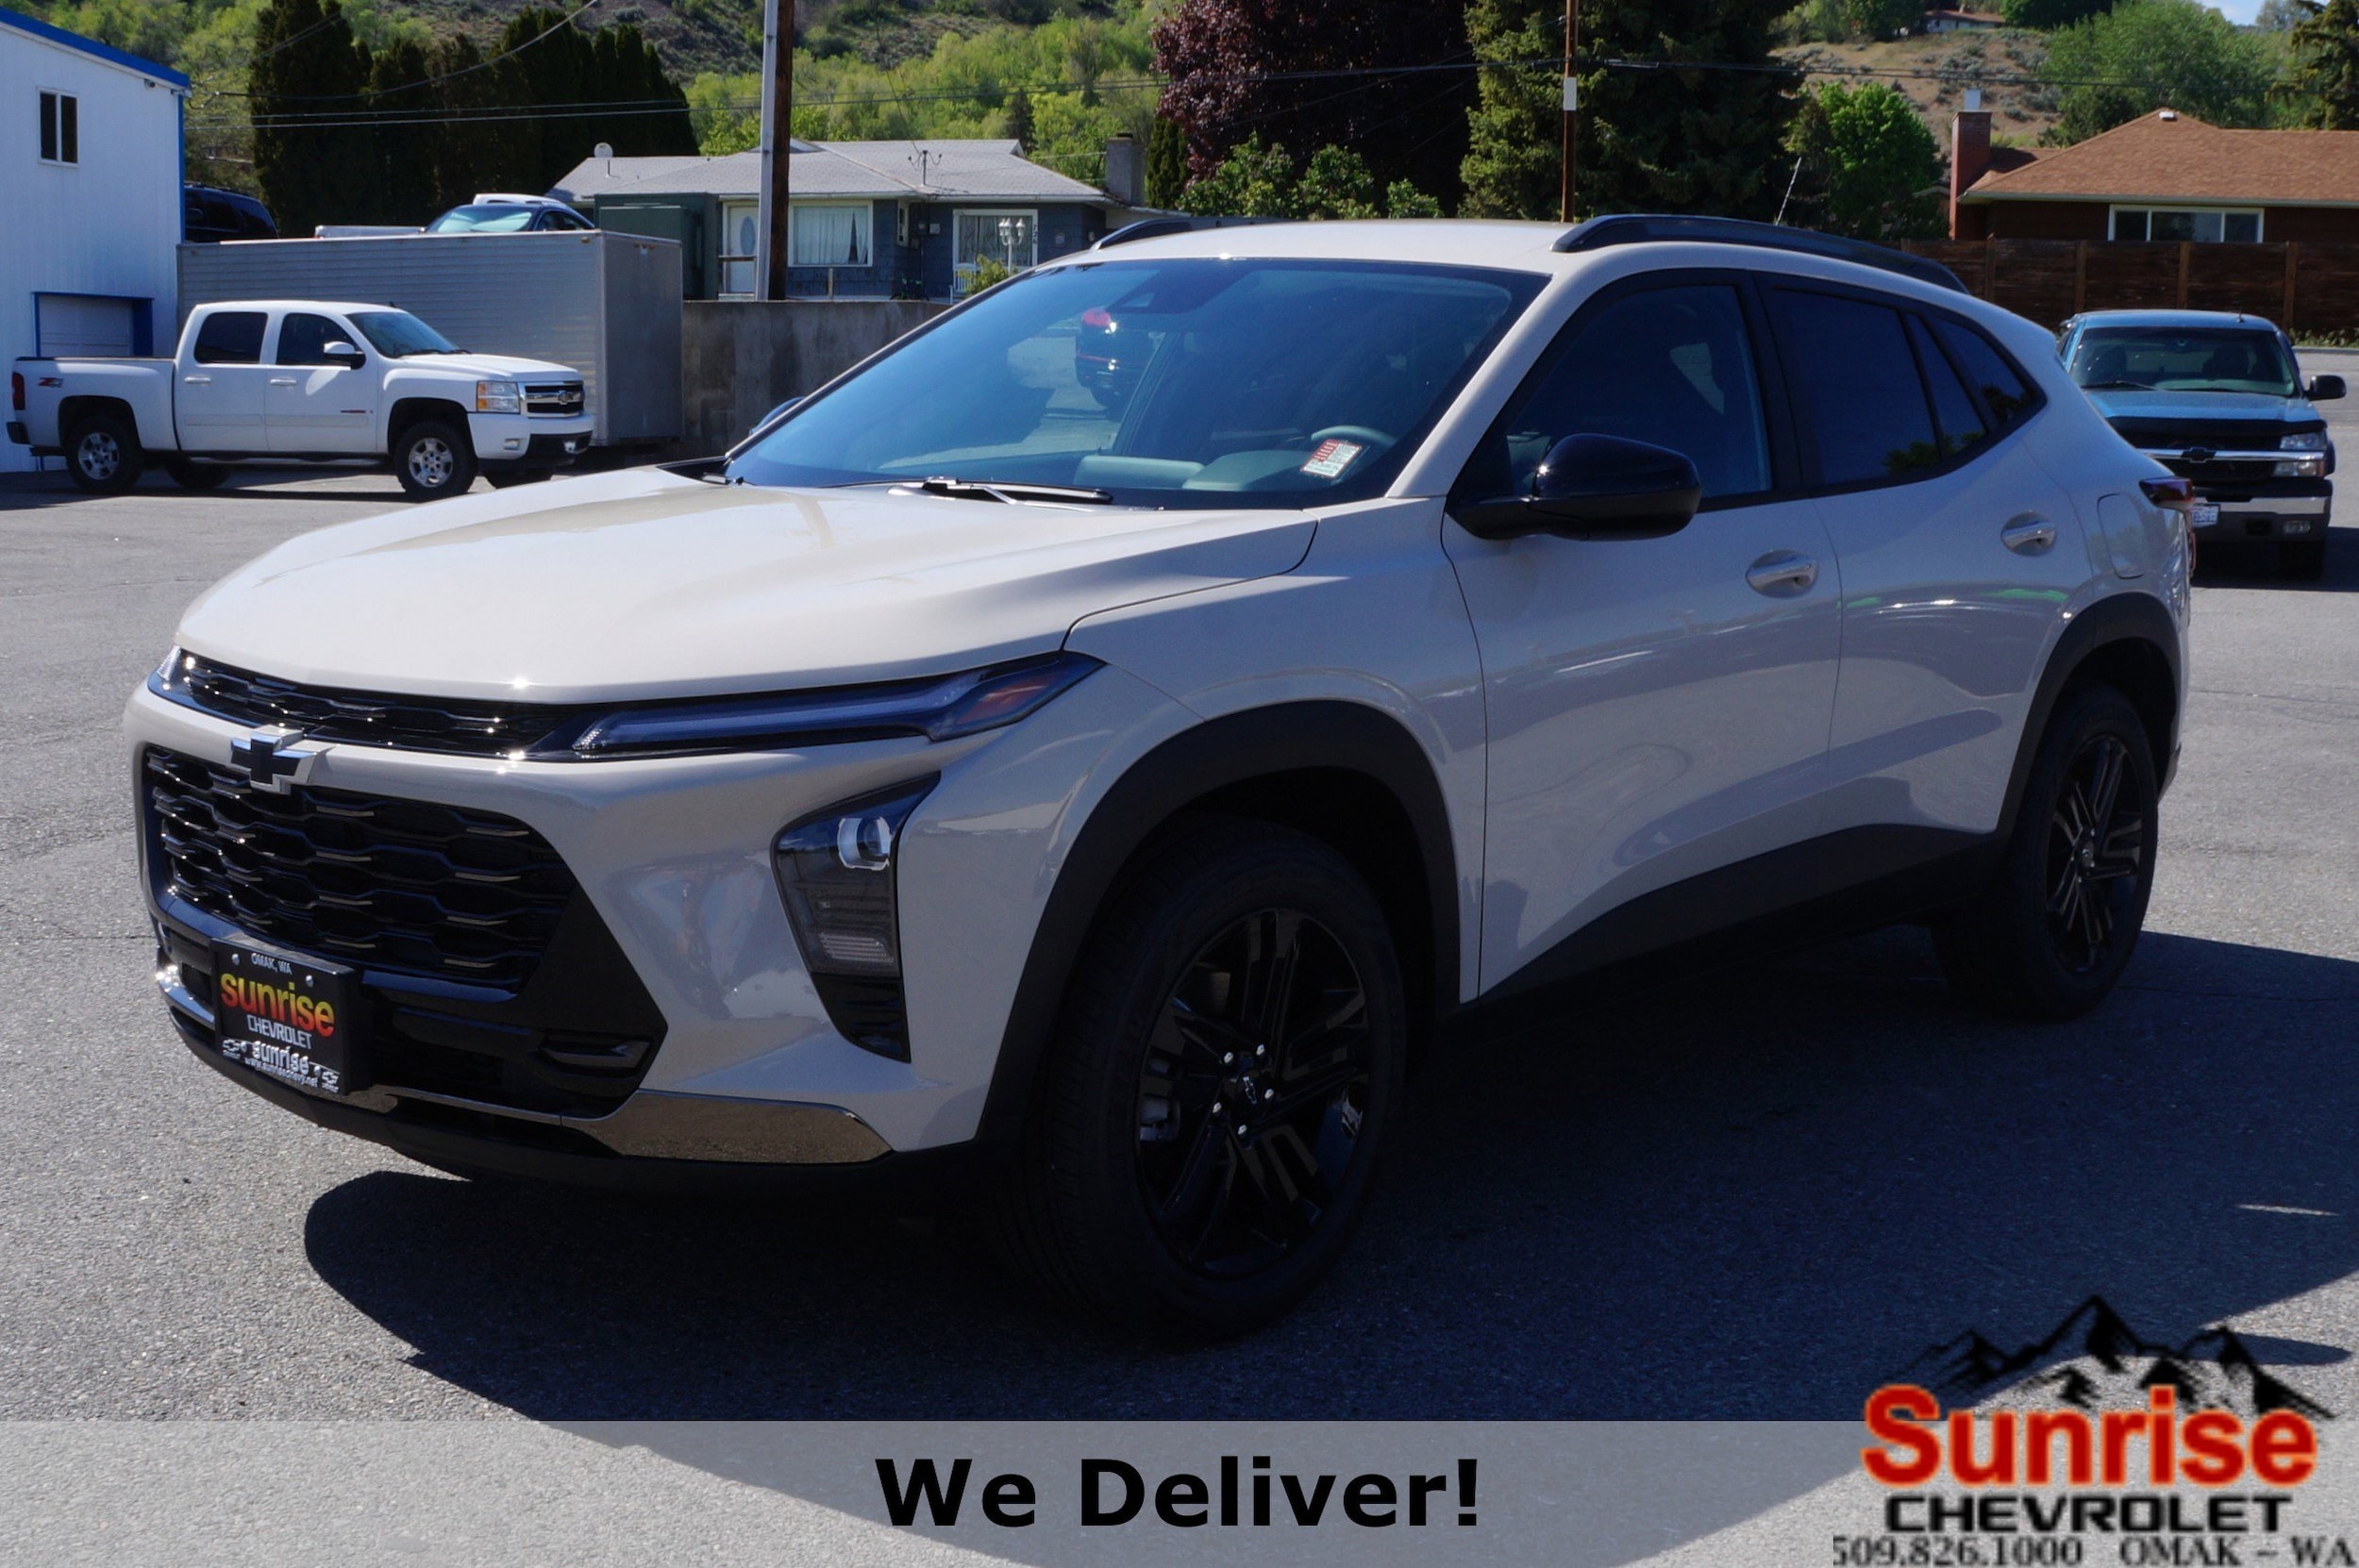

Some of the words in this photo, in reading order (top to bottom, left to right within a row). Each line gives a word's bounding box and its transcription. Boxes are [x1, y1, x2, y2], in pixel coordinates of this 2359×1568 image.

[277, 960, 293, 976] WA
[220, 973, 336, 1037] sunrise
[246, 1014, 312, 1050] CHEVROLET
[251, 1040, 310, 1076] sunrise
